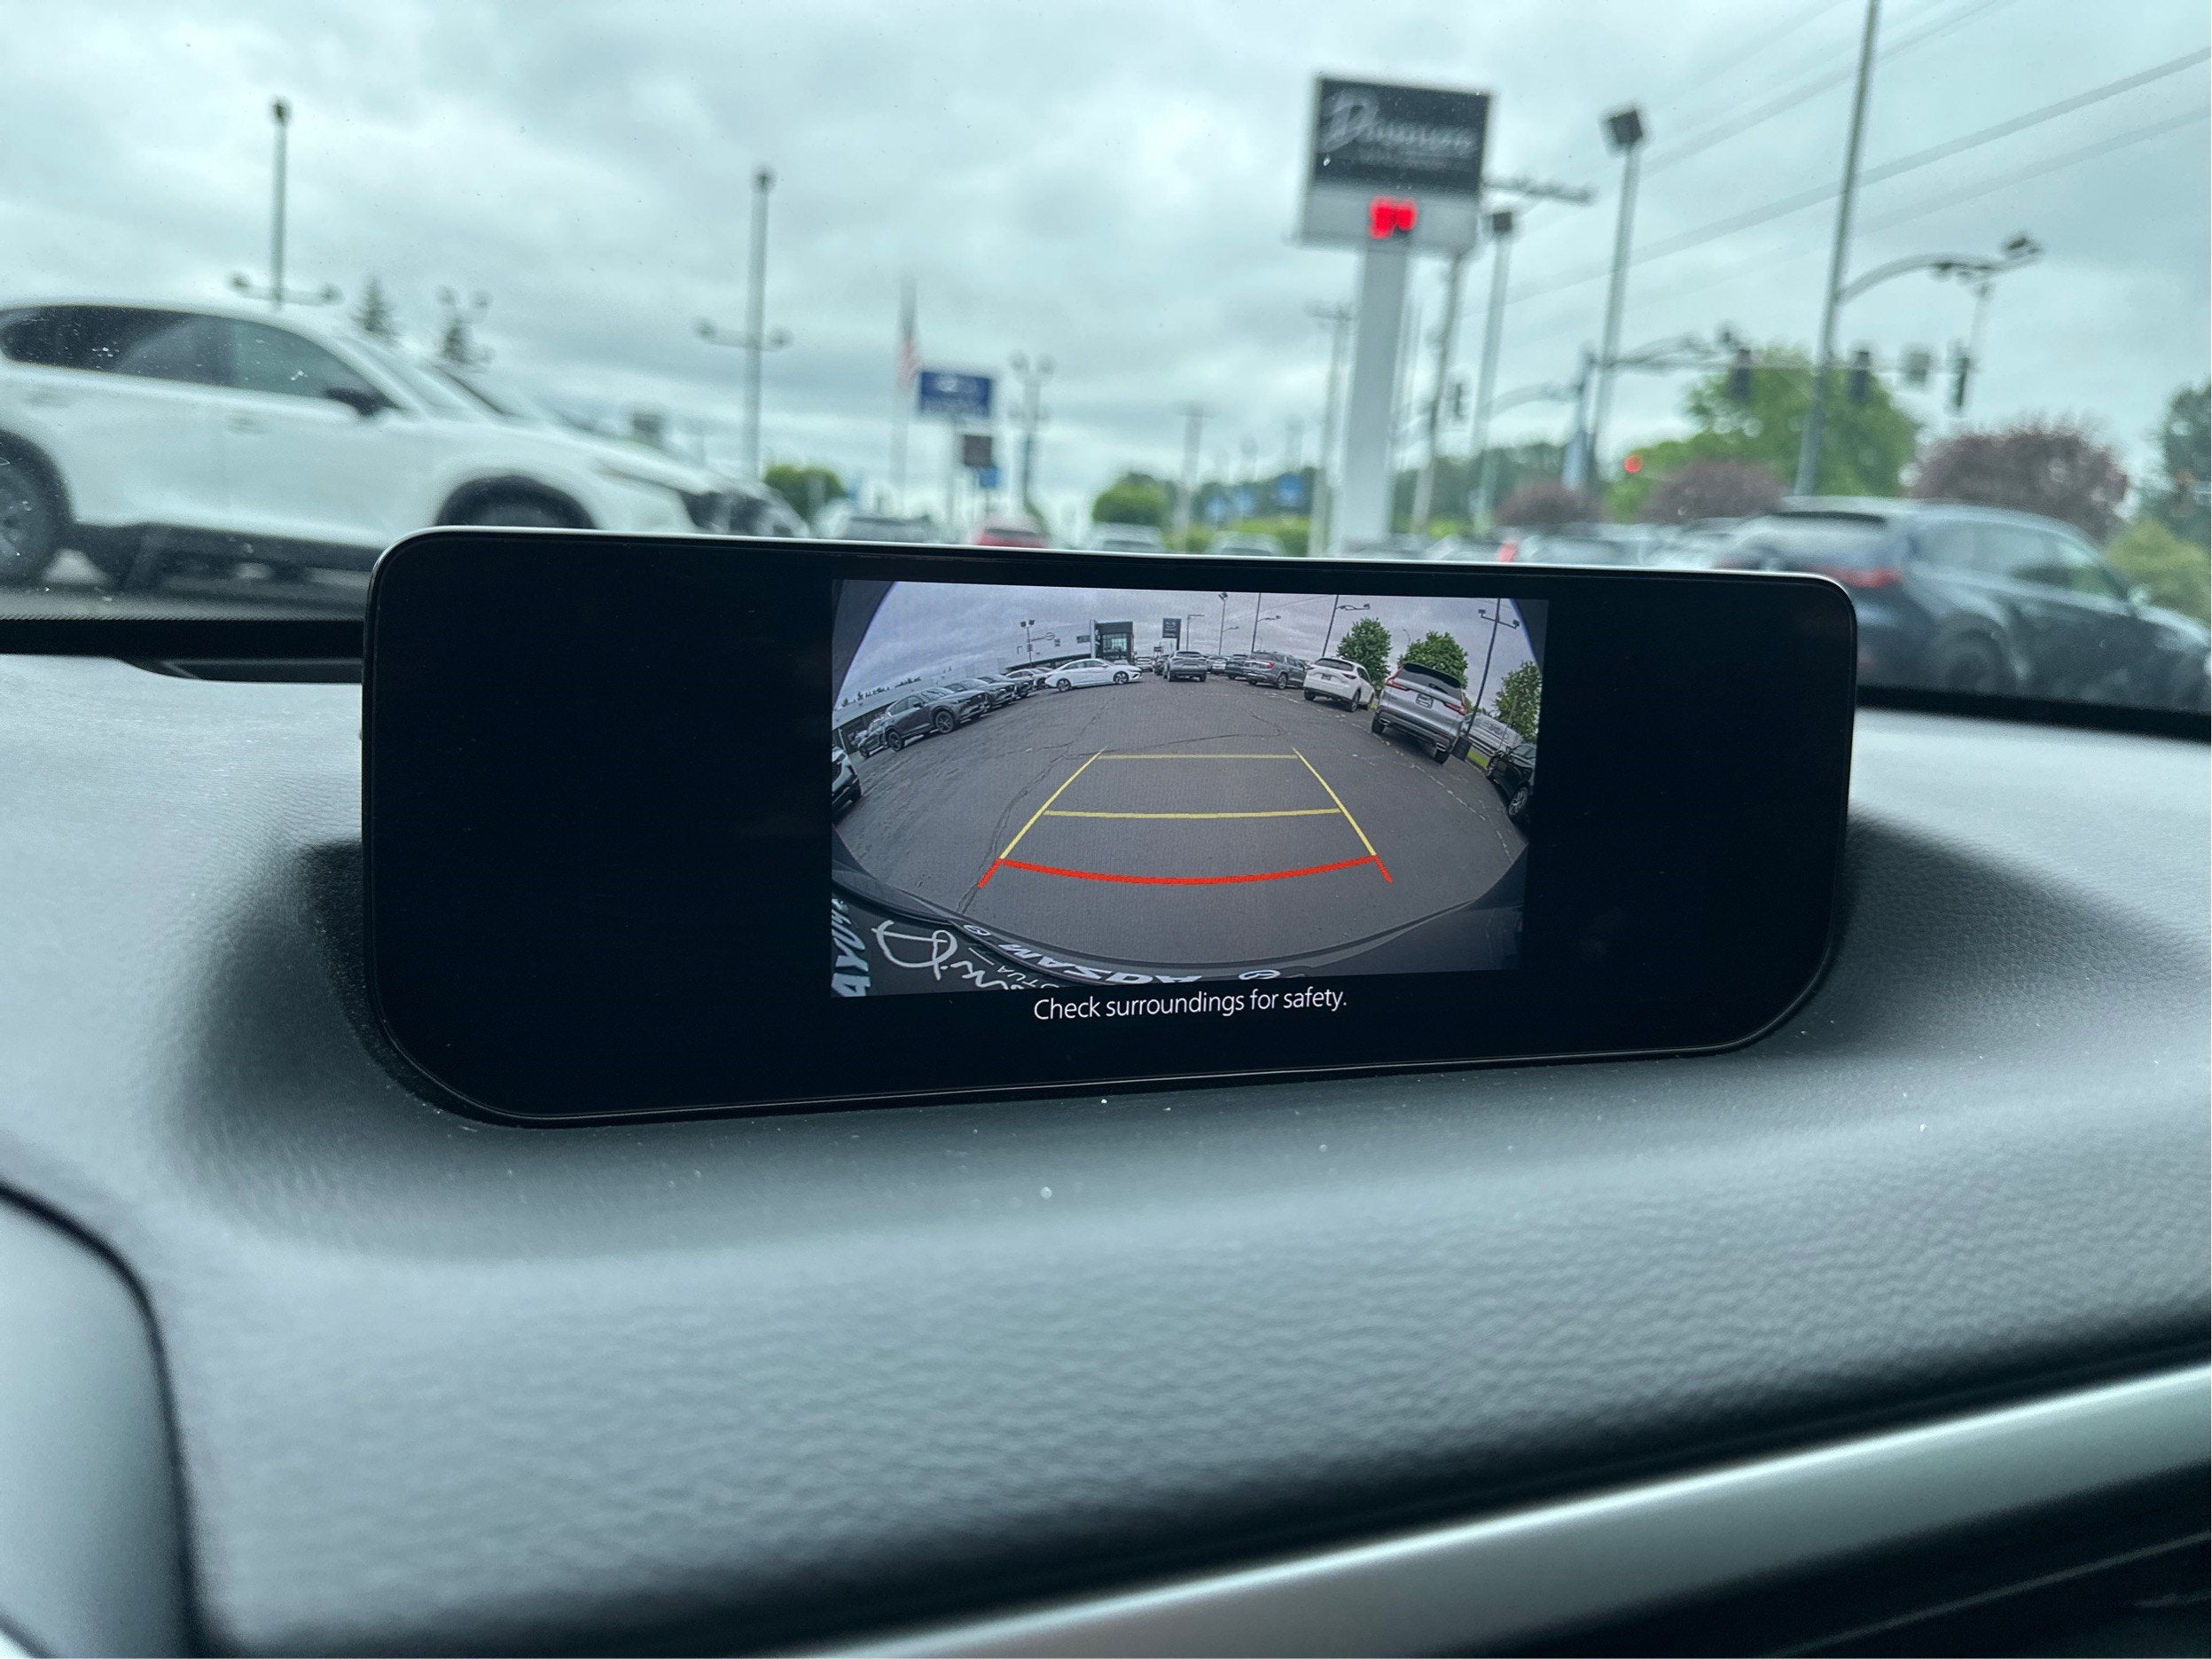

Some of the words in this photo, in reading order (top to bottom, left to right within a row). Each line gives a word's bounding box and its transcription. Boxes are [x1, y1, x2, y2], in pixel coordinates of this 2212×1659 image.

[1034, 995, 1101, 1021] Check
[1106, 990, 1245, 1017] surroundings
[1249, 988, 1279, 1010] for
[1282, 986, 1347, 1012] safety.
